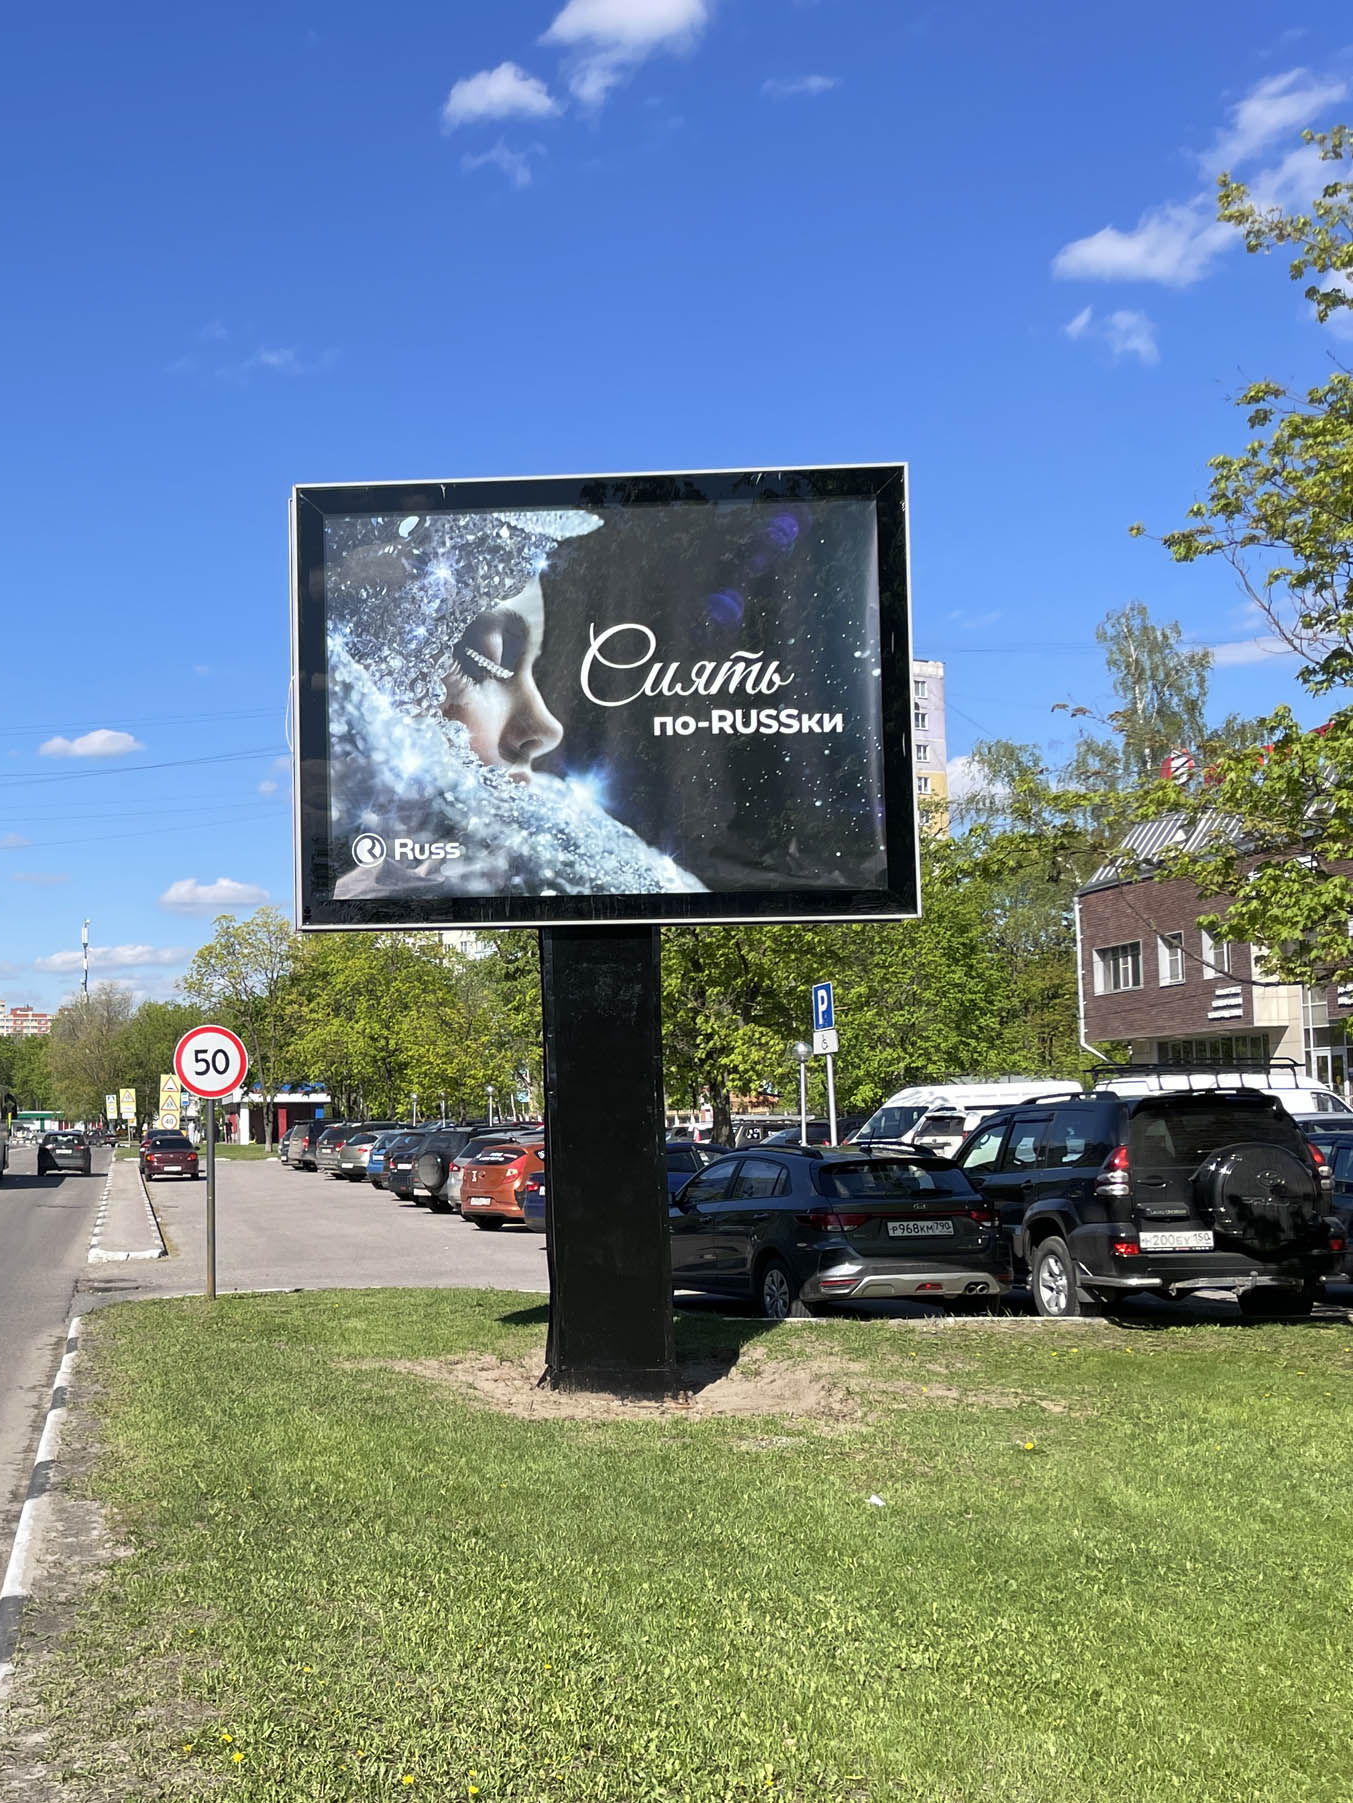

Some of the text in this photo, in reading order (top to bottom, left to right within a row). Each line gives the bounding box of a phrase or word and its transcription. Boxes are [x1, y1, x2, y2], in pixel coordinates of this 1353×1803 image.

[580, 622, 795, 707] Сиять
[653, 708, 844, 736] по-RUSSки
[394, 838, 462, 861] Russ
[194, 1048, 230, 1076] 50
